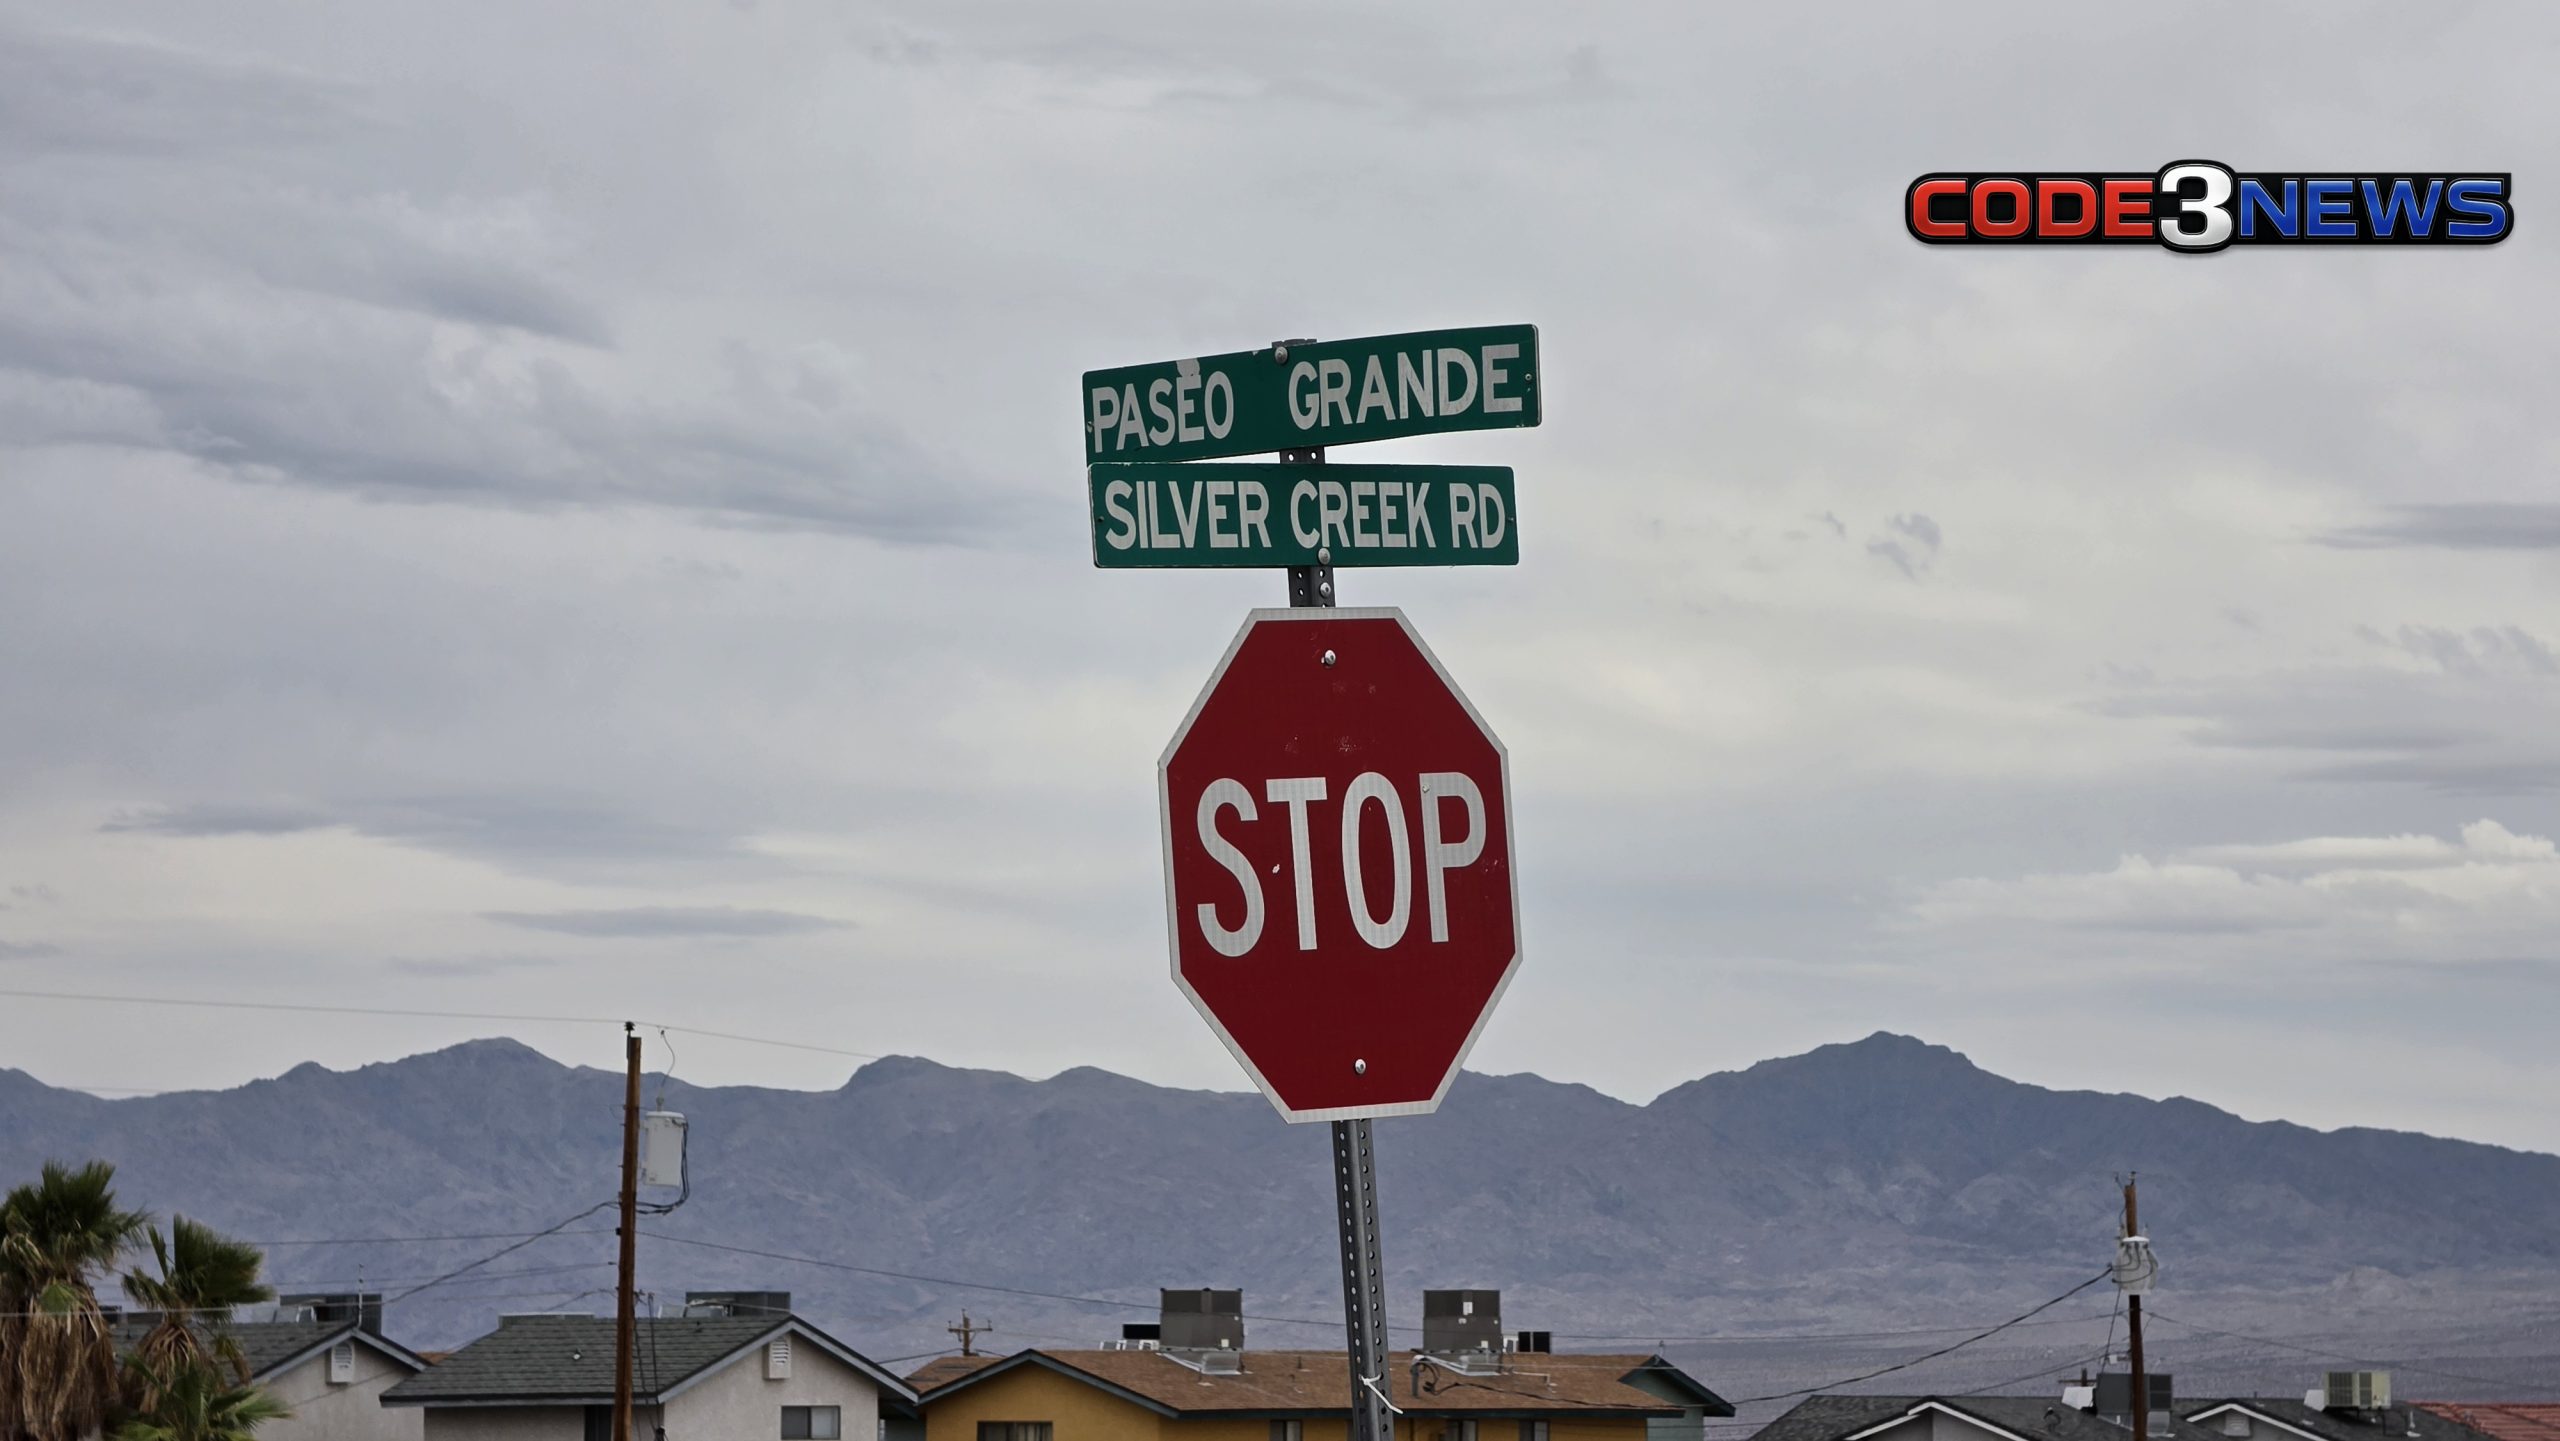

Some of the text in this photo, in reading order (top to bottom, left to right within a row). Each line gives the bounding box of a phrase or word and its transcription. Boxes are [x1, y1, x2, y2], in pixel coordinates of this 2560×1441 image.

[1091, 343, 1523, 454] PASEO GRANDE
[1104, 478, 1506, 550] SILVER CREEK RD
[1197, 771, 1487, 957] STOP
